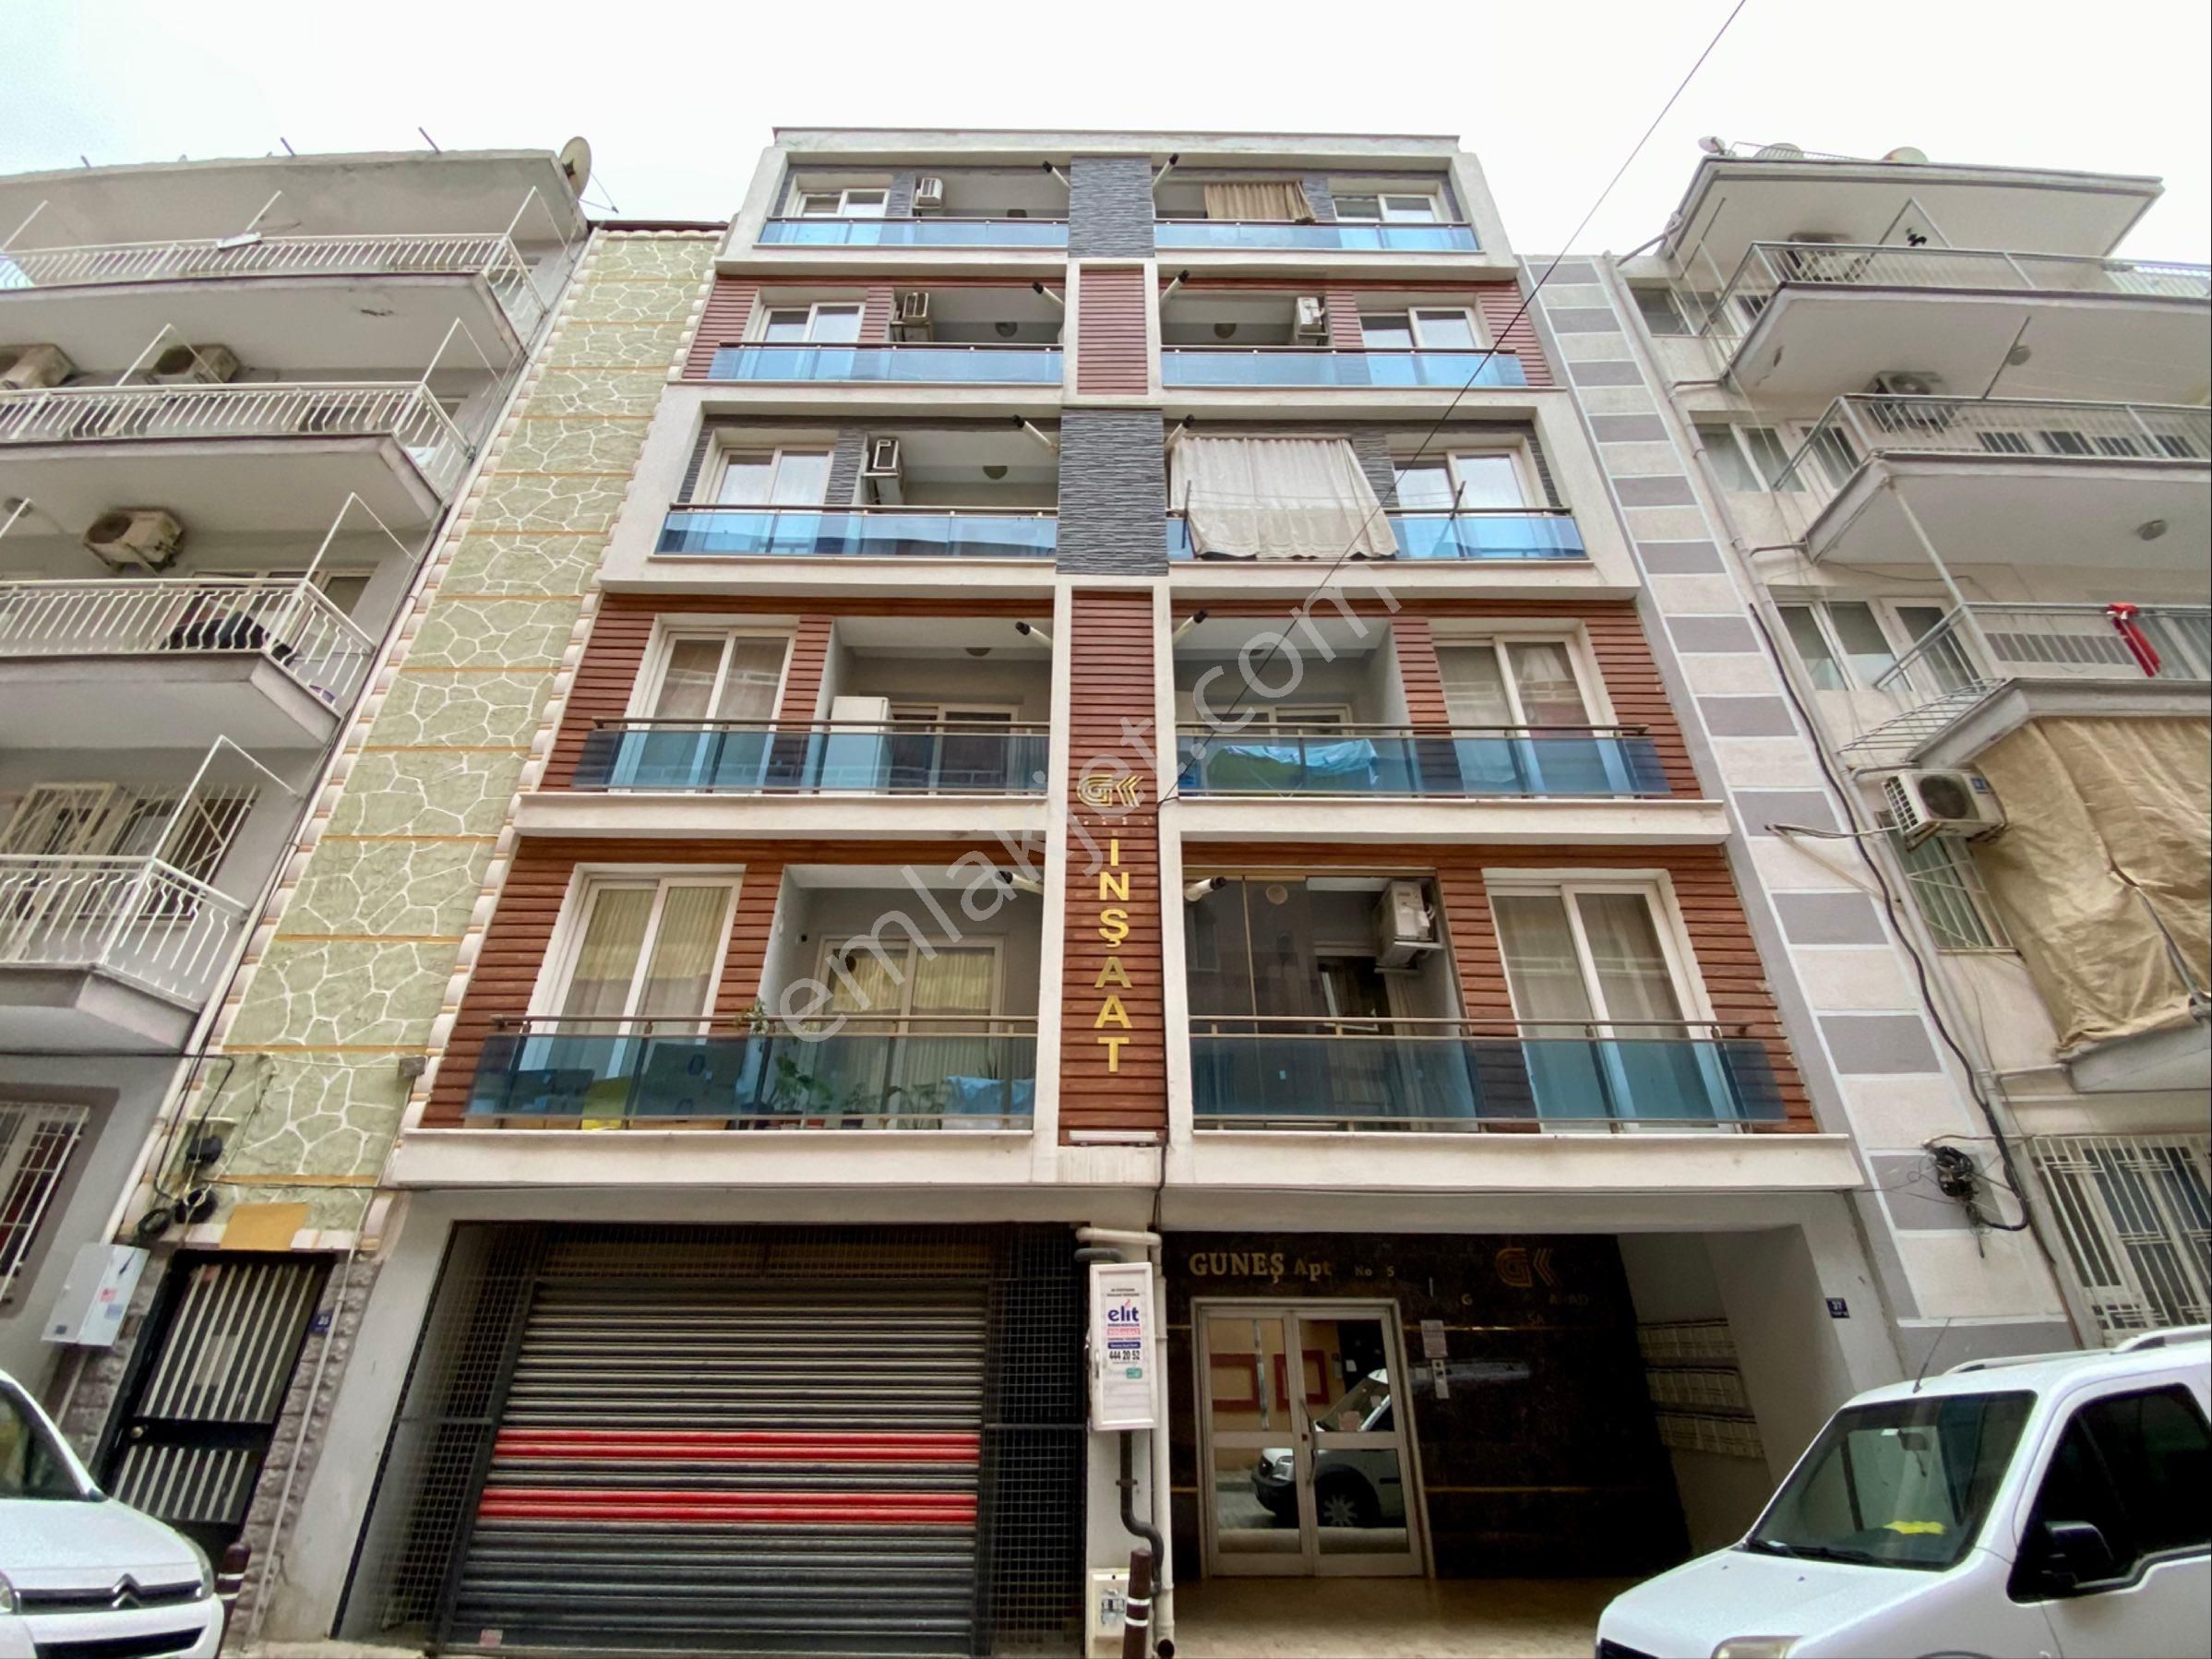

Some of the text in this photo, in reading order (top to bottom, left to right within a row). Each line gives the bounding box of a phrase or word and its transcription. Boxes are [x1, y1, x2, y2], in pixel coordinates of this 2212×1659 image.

[1294, 1258, 1333, 1282] Apt
[1354, 1264, 1373, 1276] No
[1107, 1301, 1140, 1322] elit
[1109, 1350, 1141, 1361] 444 20 52
